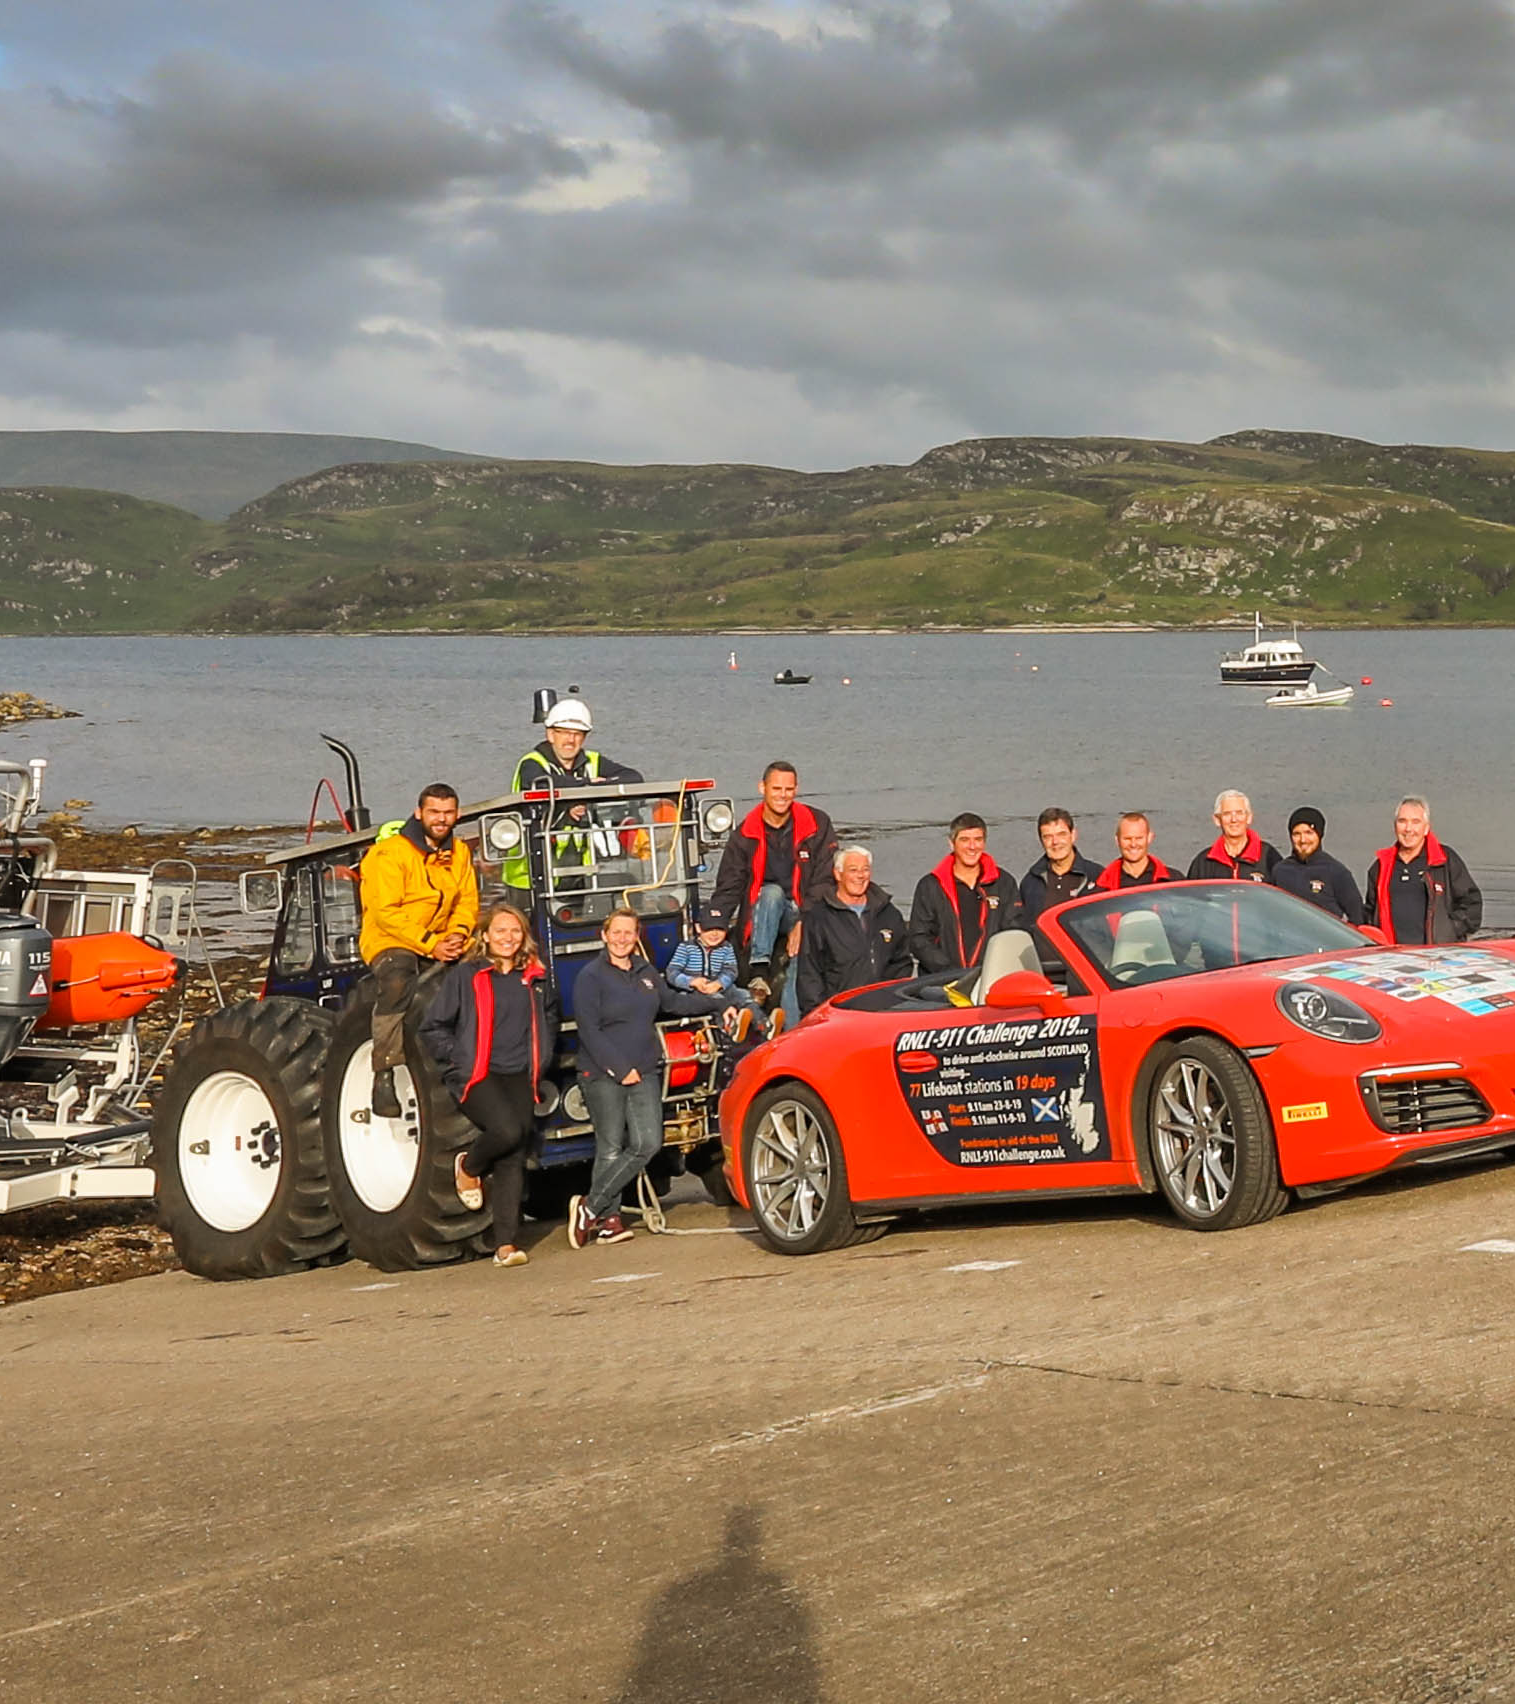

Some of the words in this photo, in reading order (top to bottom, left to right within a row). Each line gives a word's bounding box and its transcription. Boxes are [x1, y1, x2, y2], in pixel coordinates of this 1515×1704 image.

[28, 952, 52, 964] 115
[897, 1027, 966, 1052] RNLI-911
[966, 1022, 1038, 1046] Challenge
[1038, 1016, 1089, 1038] 2019...
[943, 1057, 951, 1066] to
[952, 1054, 970, 1065] drive
[970, 1049, 1018, 1064] anti-clockwise
[1020, 1046, 1046, 1059] around
[1047, 1043, 1089, 1057] SCOTLAND
[910, 1083, 921, 1096] 77
[922, 1081, 963, 1096] Lifeboat
[964, 1079, 1002, 1094] stations
[1003, 1076, 1014, 1091] in
[1016, 1076, 1028, 1090] 19
[1030, 1073, 1056, 1091] days
[960, 1145, 1066, 1164] RNLI-911challenge.co.uk
